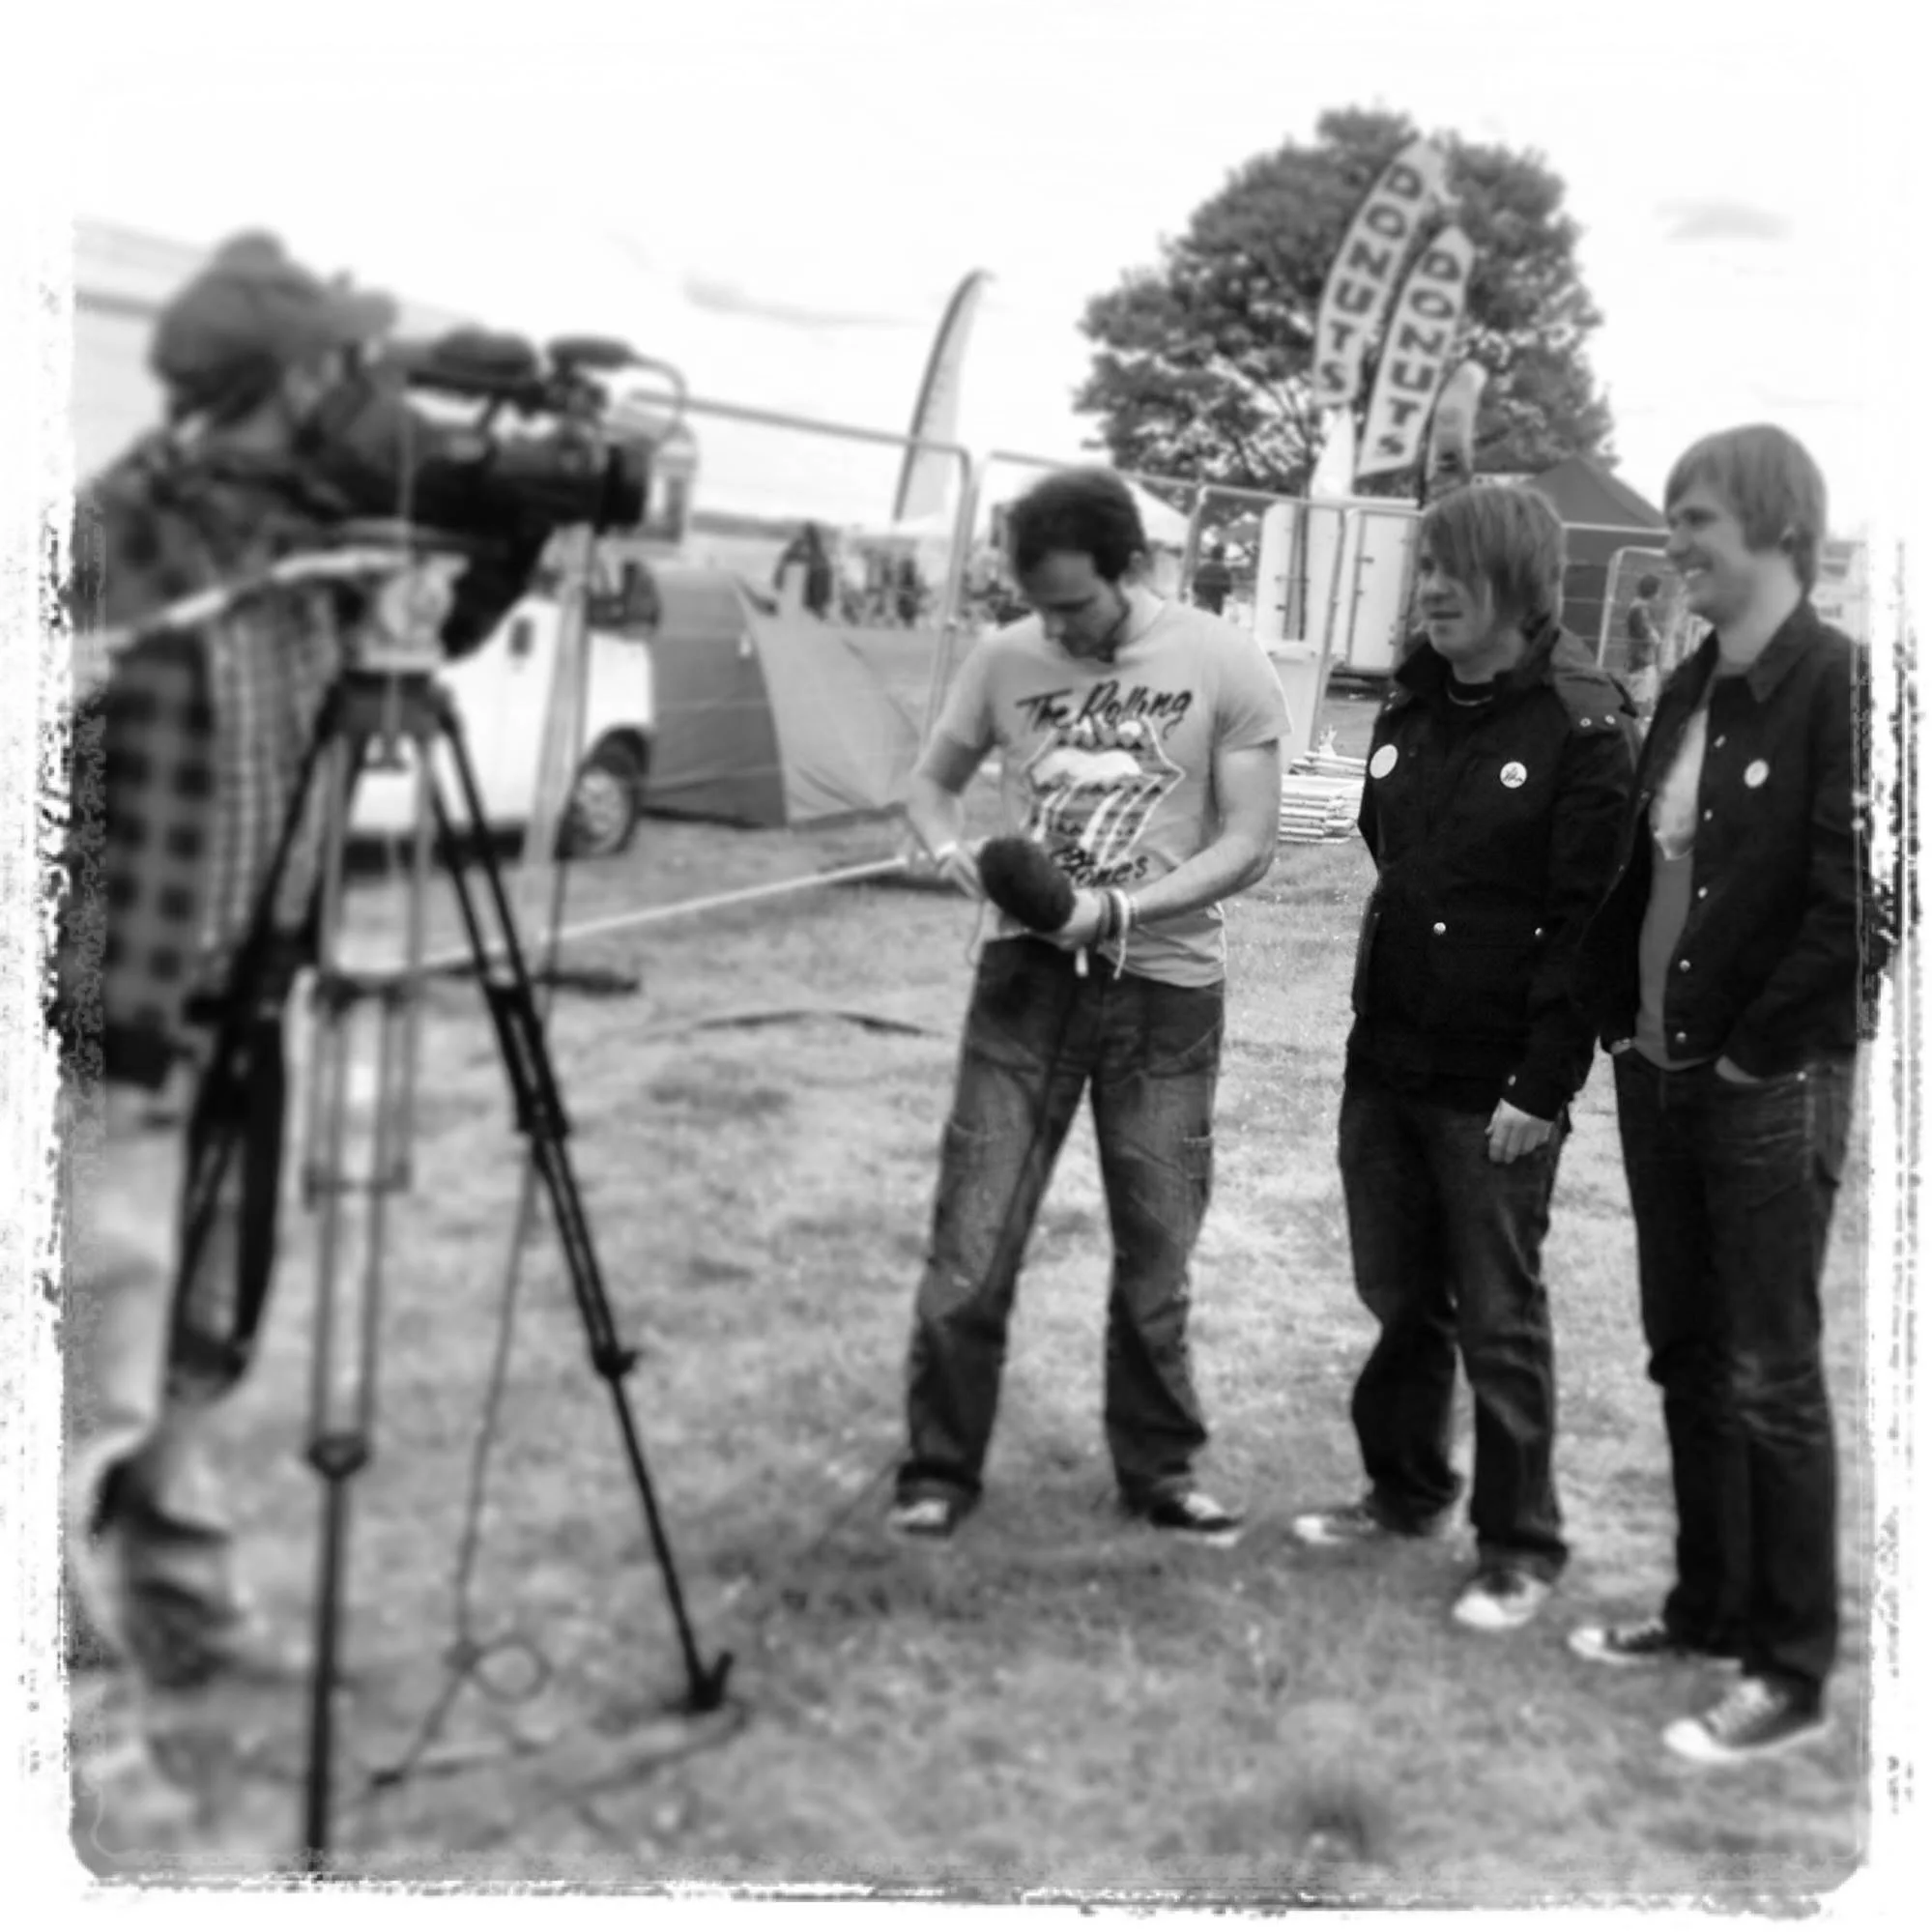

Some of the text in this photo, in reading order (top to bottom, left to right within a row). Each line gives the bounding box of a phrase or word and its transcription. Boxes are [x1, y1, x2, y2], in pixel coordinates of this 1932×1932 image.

[1319, 162, 1424, 393] DONUTS
[1378, 249, 1461, 456] DONUTS
[1015, 679, 1193, 740] The Rolling
